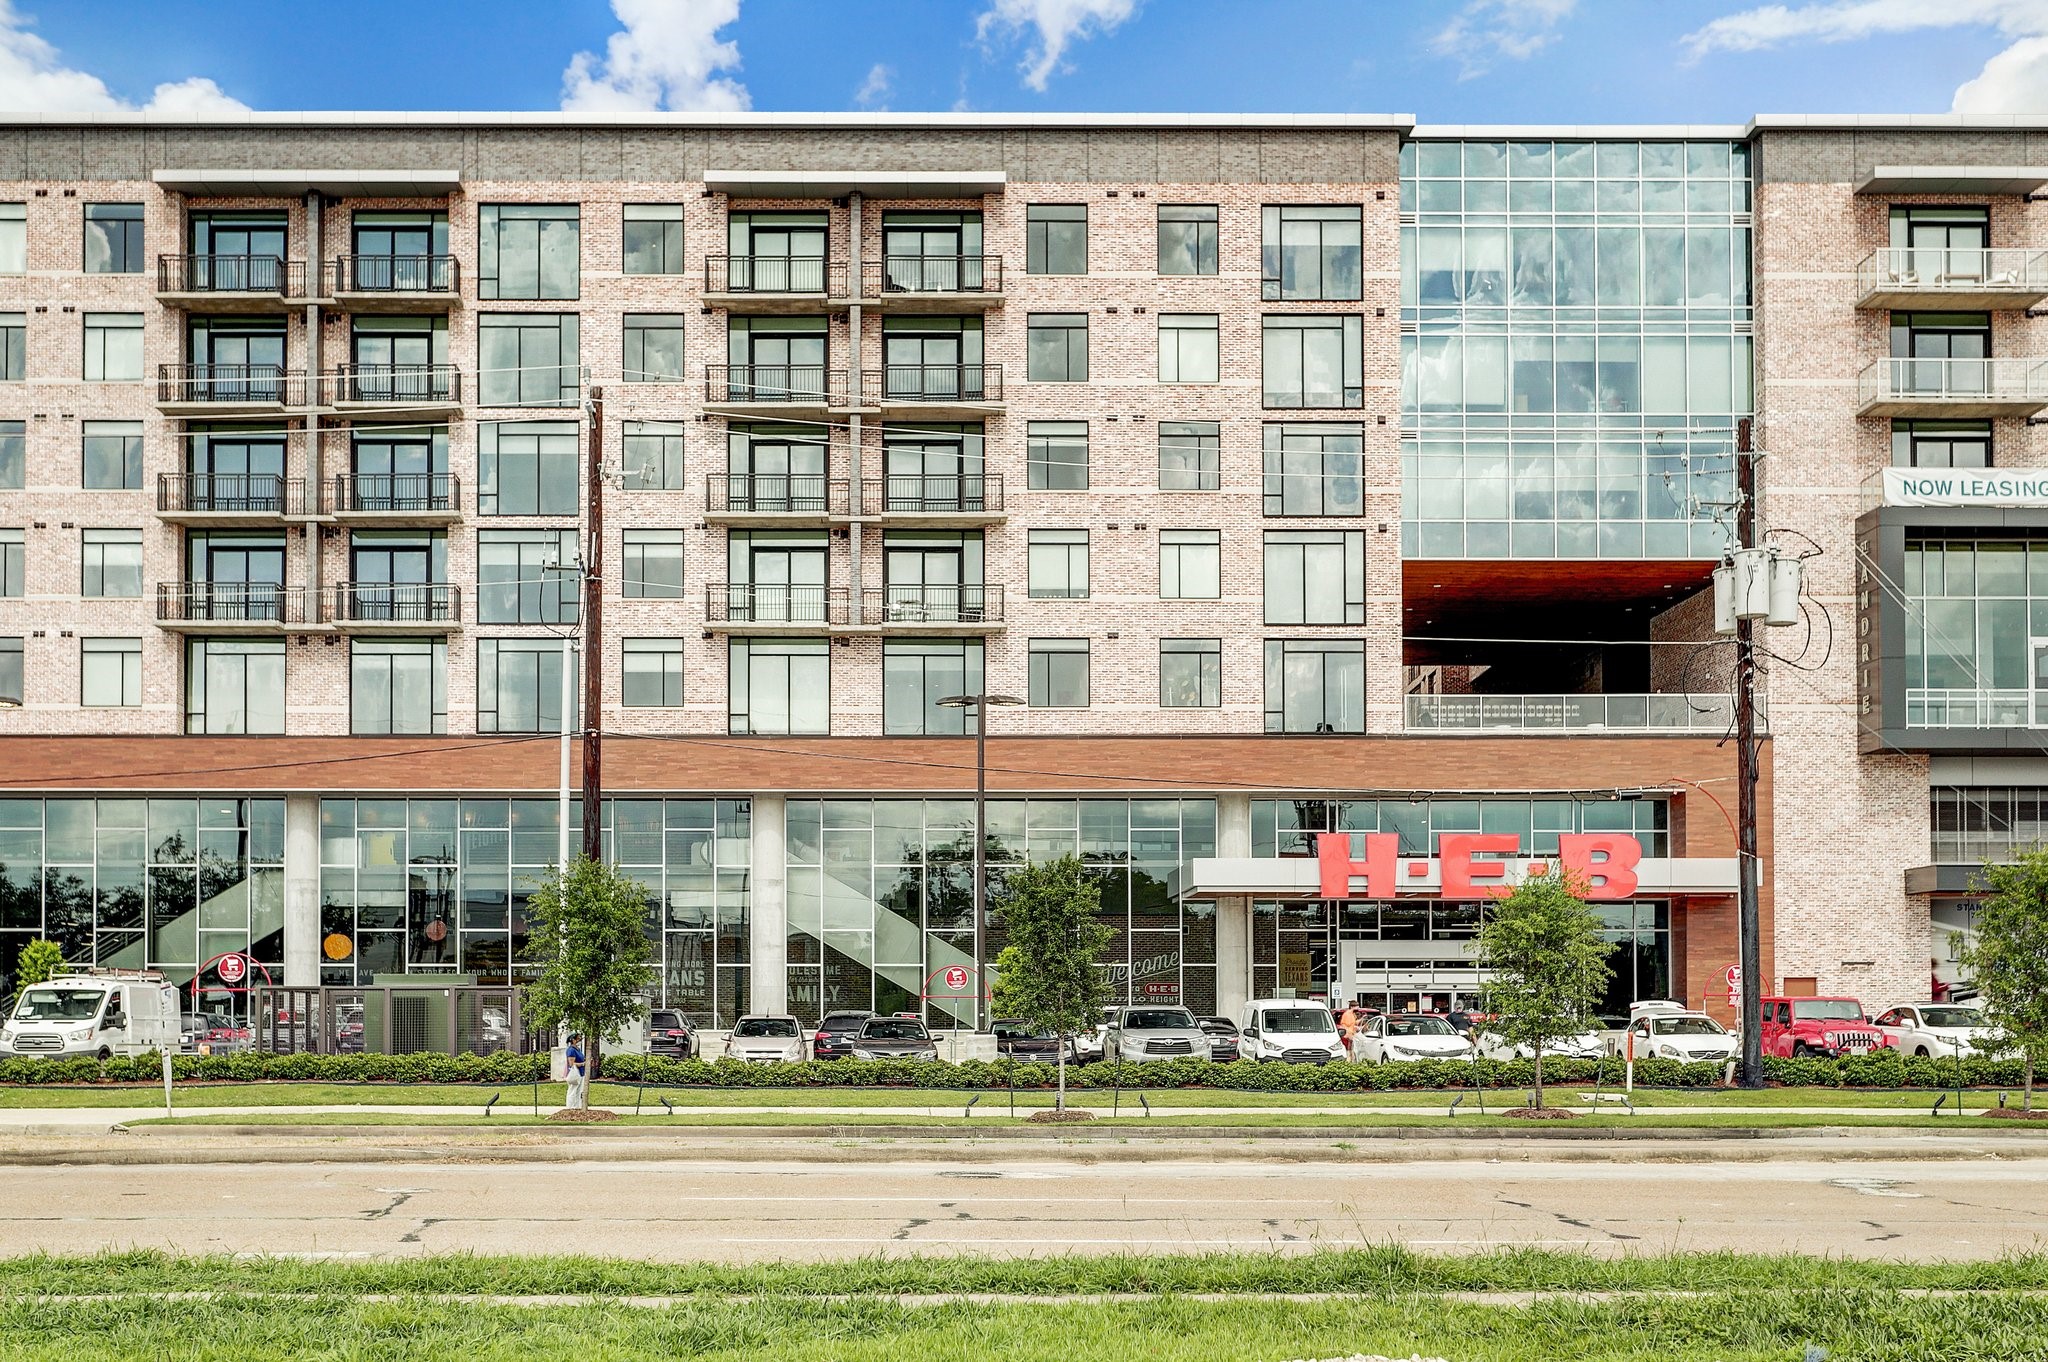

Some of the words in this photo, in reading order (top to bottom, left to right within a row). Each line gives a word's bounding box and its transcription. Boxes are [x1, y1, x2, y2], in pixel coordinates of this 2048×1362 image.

[1903, 480, 1953, 496] NOW
[1960, 480, 2048, 497] LEASING
[1860, 565, 1871, 715] ANDRIE
[685, 960, 705, 968] MORE
[1100, 951, 1179, 984] Wecome
[466, 969, 487, 977] YOUR
[491, 969, 517, 977] WHOE
[788, 966, 818, 975] ULES
[1285, 971, 1309, 982] TEXANS
[675, 989, 706, 997] TABLE
[788, 985, 841, 1002] AMIY
